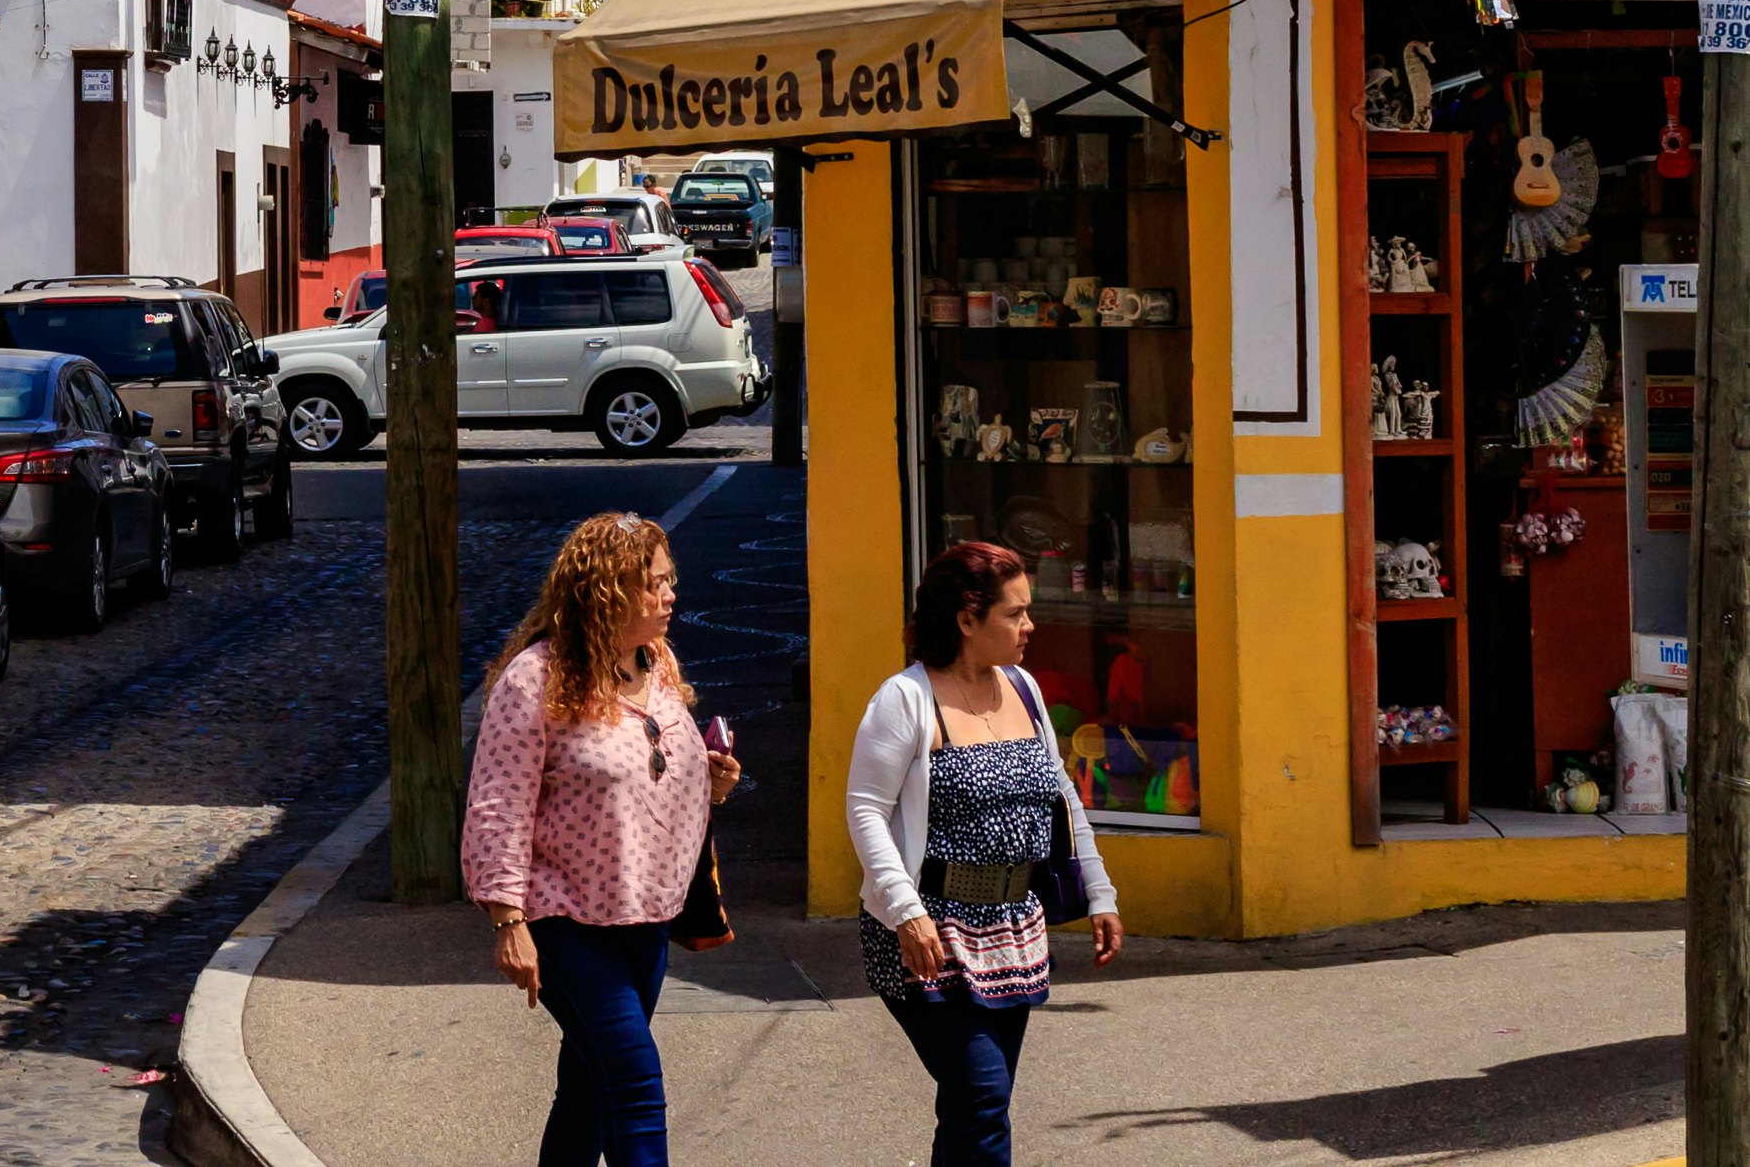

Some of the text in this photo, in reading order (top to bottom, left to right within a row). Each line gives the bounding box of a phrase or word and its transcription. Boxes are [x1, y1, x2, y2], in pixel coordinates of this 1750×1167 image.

[401, 3, 415, 11] 39
[591, 38, 959, 133] Dulcería Leal's
